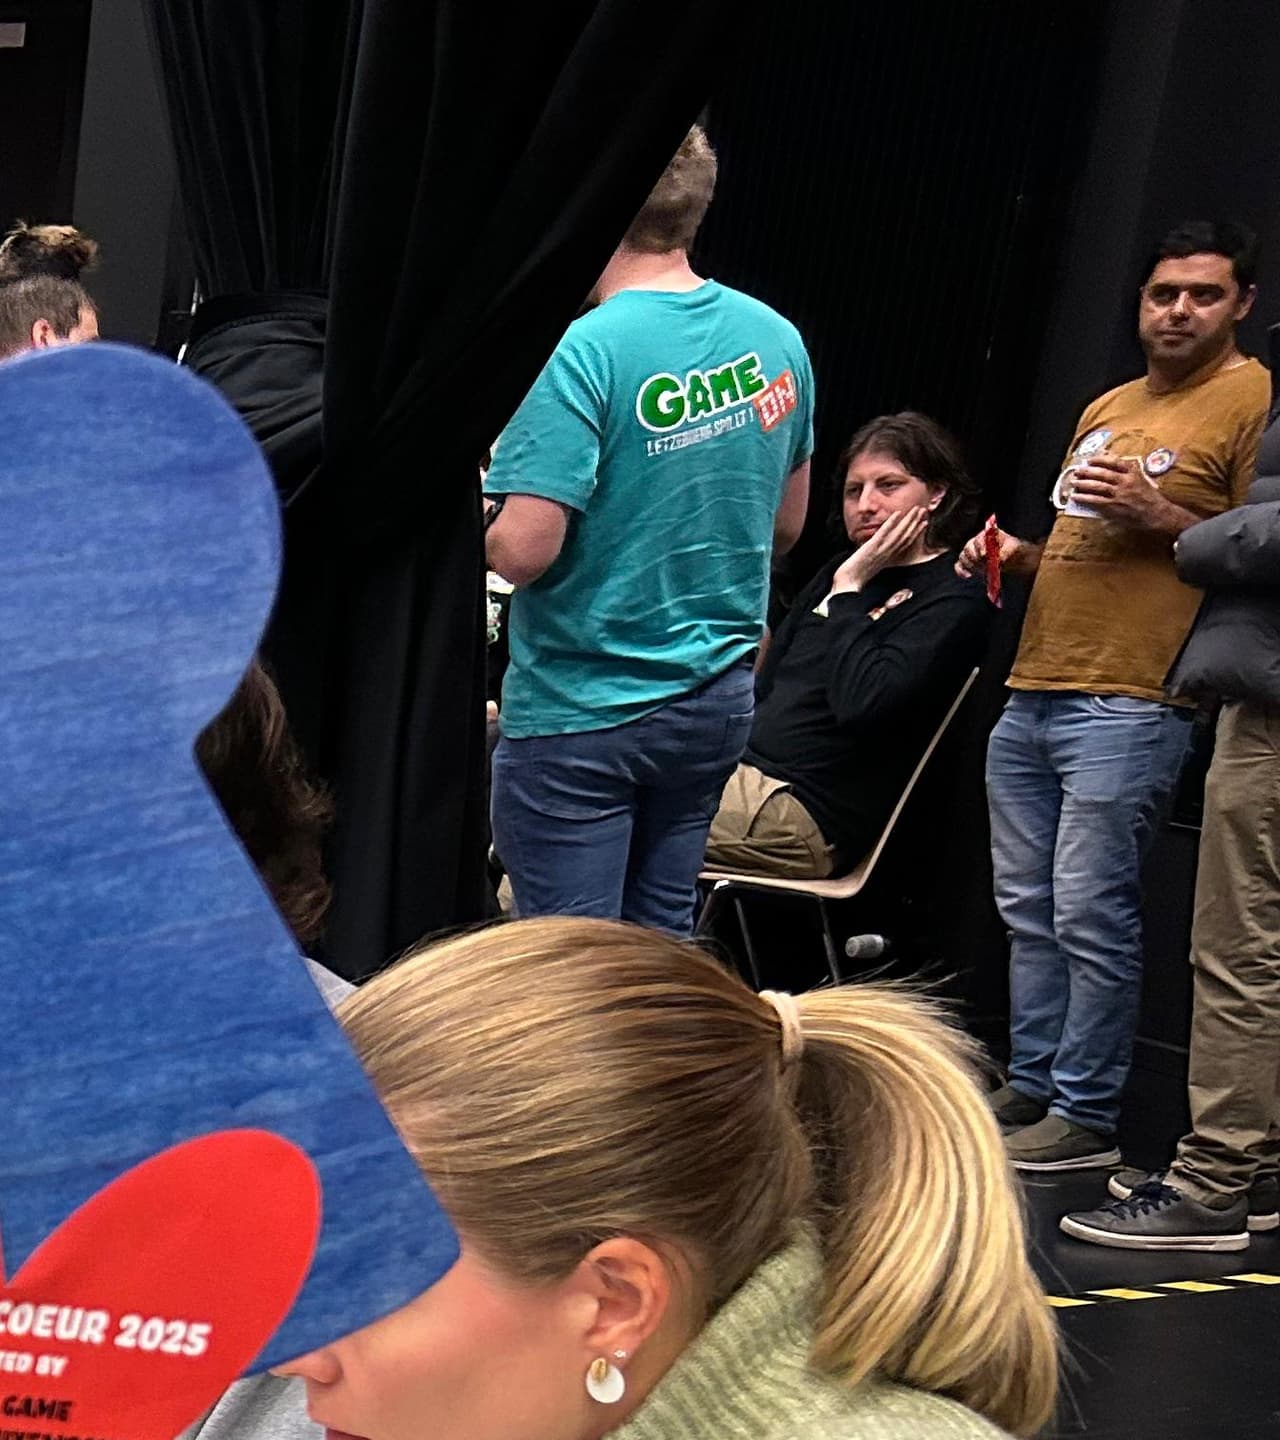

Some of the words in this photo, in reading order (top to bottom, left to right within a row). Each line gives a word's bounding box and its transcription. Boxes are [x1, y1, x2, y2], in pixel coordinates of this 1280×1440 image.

[636, 352, 768, 432] GAME
[114, 1314, 213, 1356] 2025
[36, 1355, 68, 1377] BY
[2, 1394, 74, 1422] GAME
